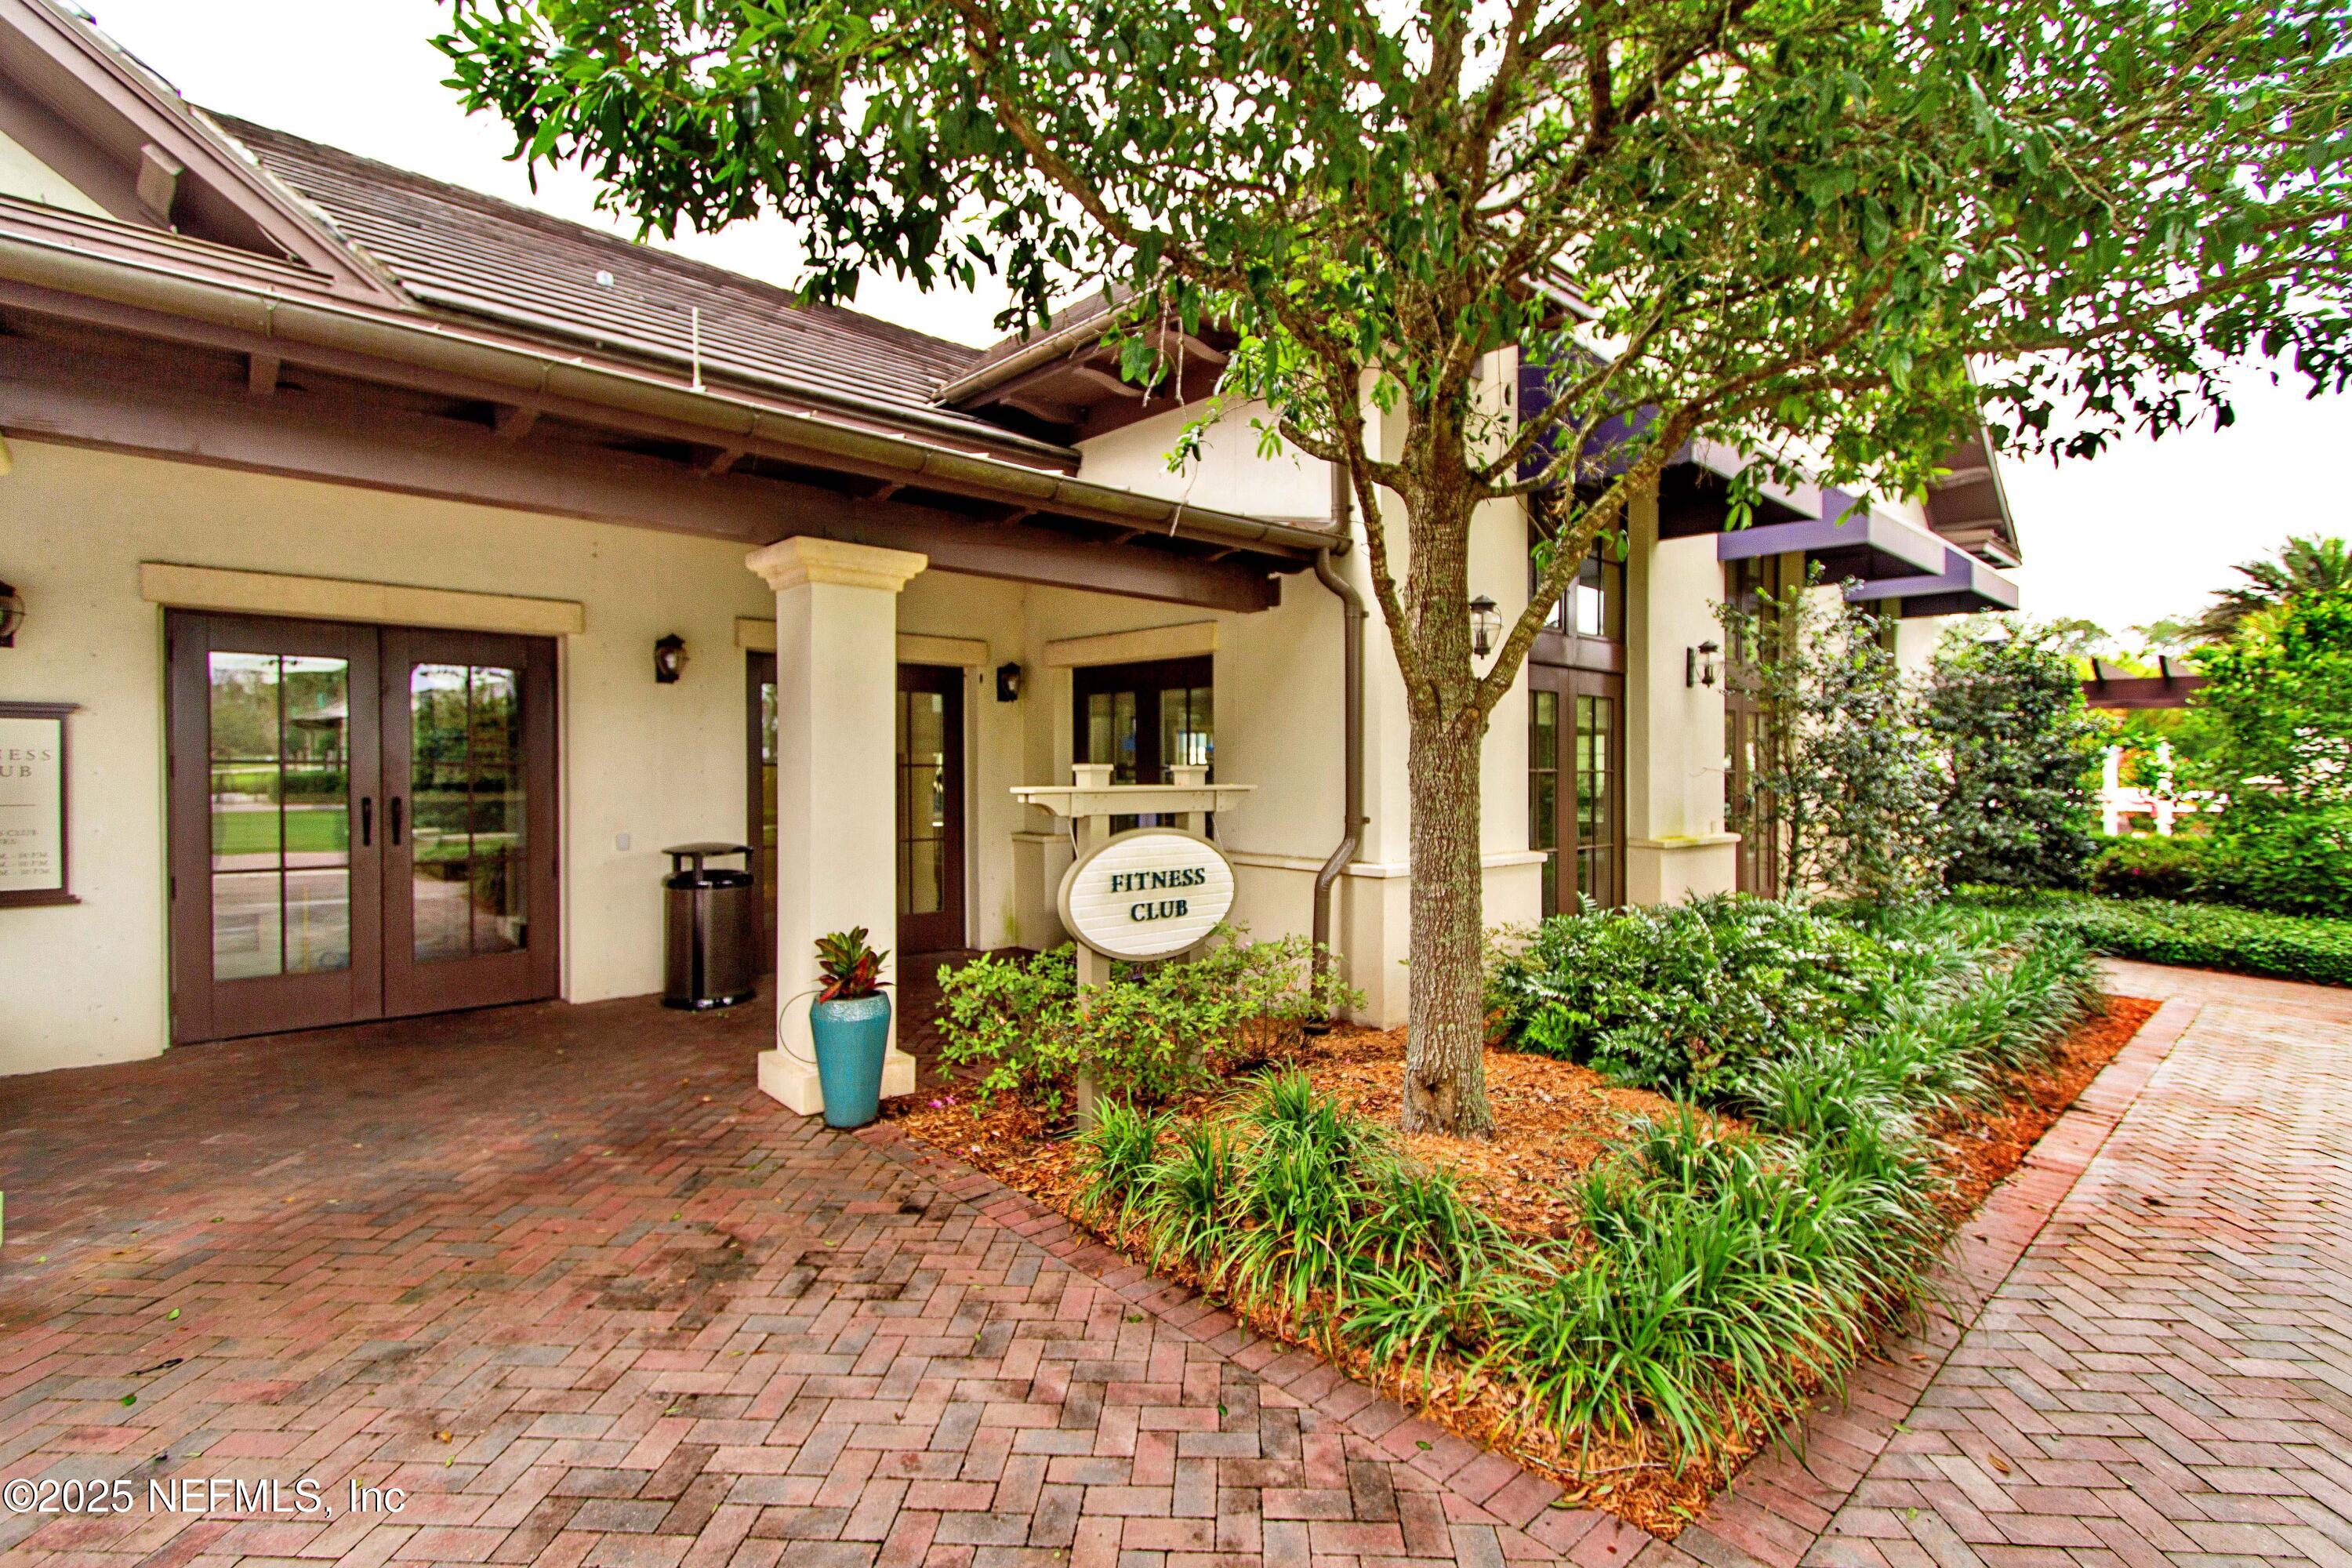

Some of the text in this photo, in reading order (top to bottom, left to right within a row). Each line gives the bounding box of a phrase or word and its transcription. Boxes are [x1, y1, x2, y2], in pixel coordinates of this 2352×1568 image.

[0, 749, 52, 761] ESS
[1111, 867, 1206, 893] FITNESS
[1131, 899, 1189, 922] CLUB
